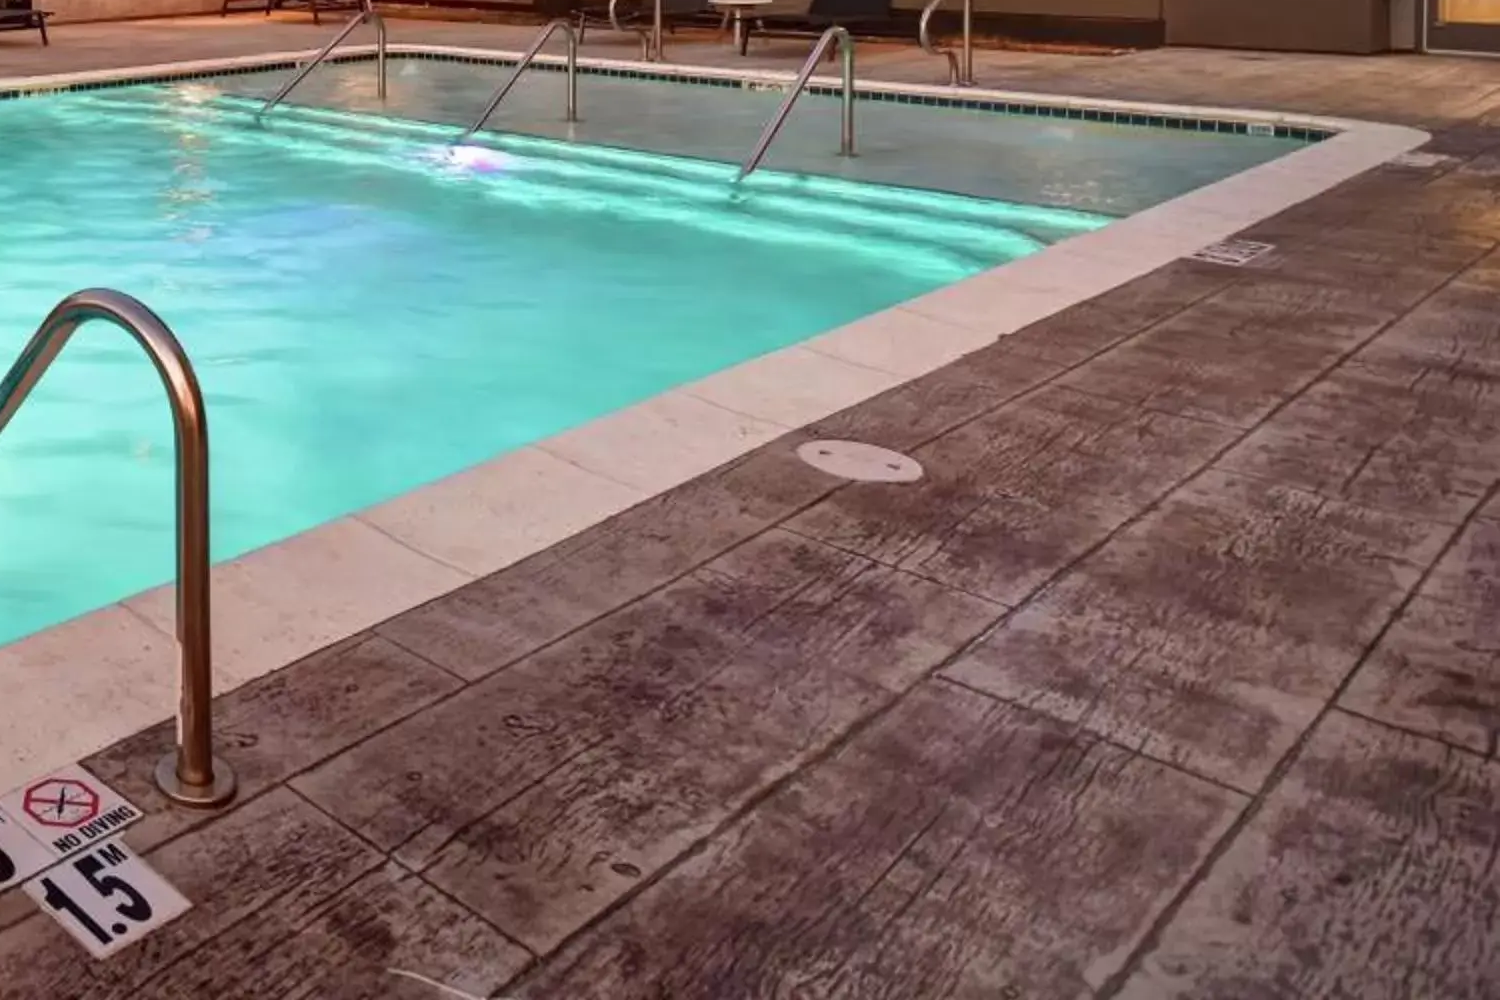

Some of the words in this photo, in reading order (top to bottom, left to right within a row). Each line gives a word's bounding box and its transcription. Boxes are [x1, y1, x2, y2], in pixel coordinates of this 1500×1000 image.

[52, 833, 81, 853] NO
[79, 805, 136, 839] DIVING
[41, 854, 152, 945] 1.5
[97, 843, 128, 866] M
